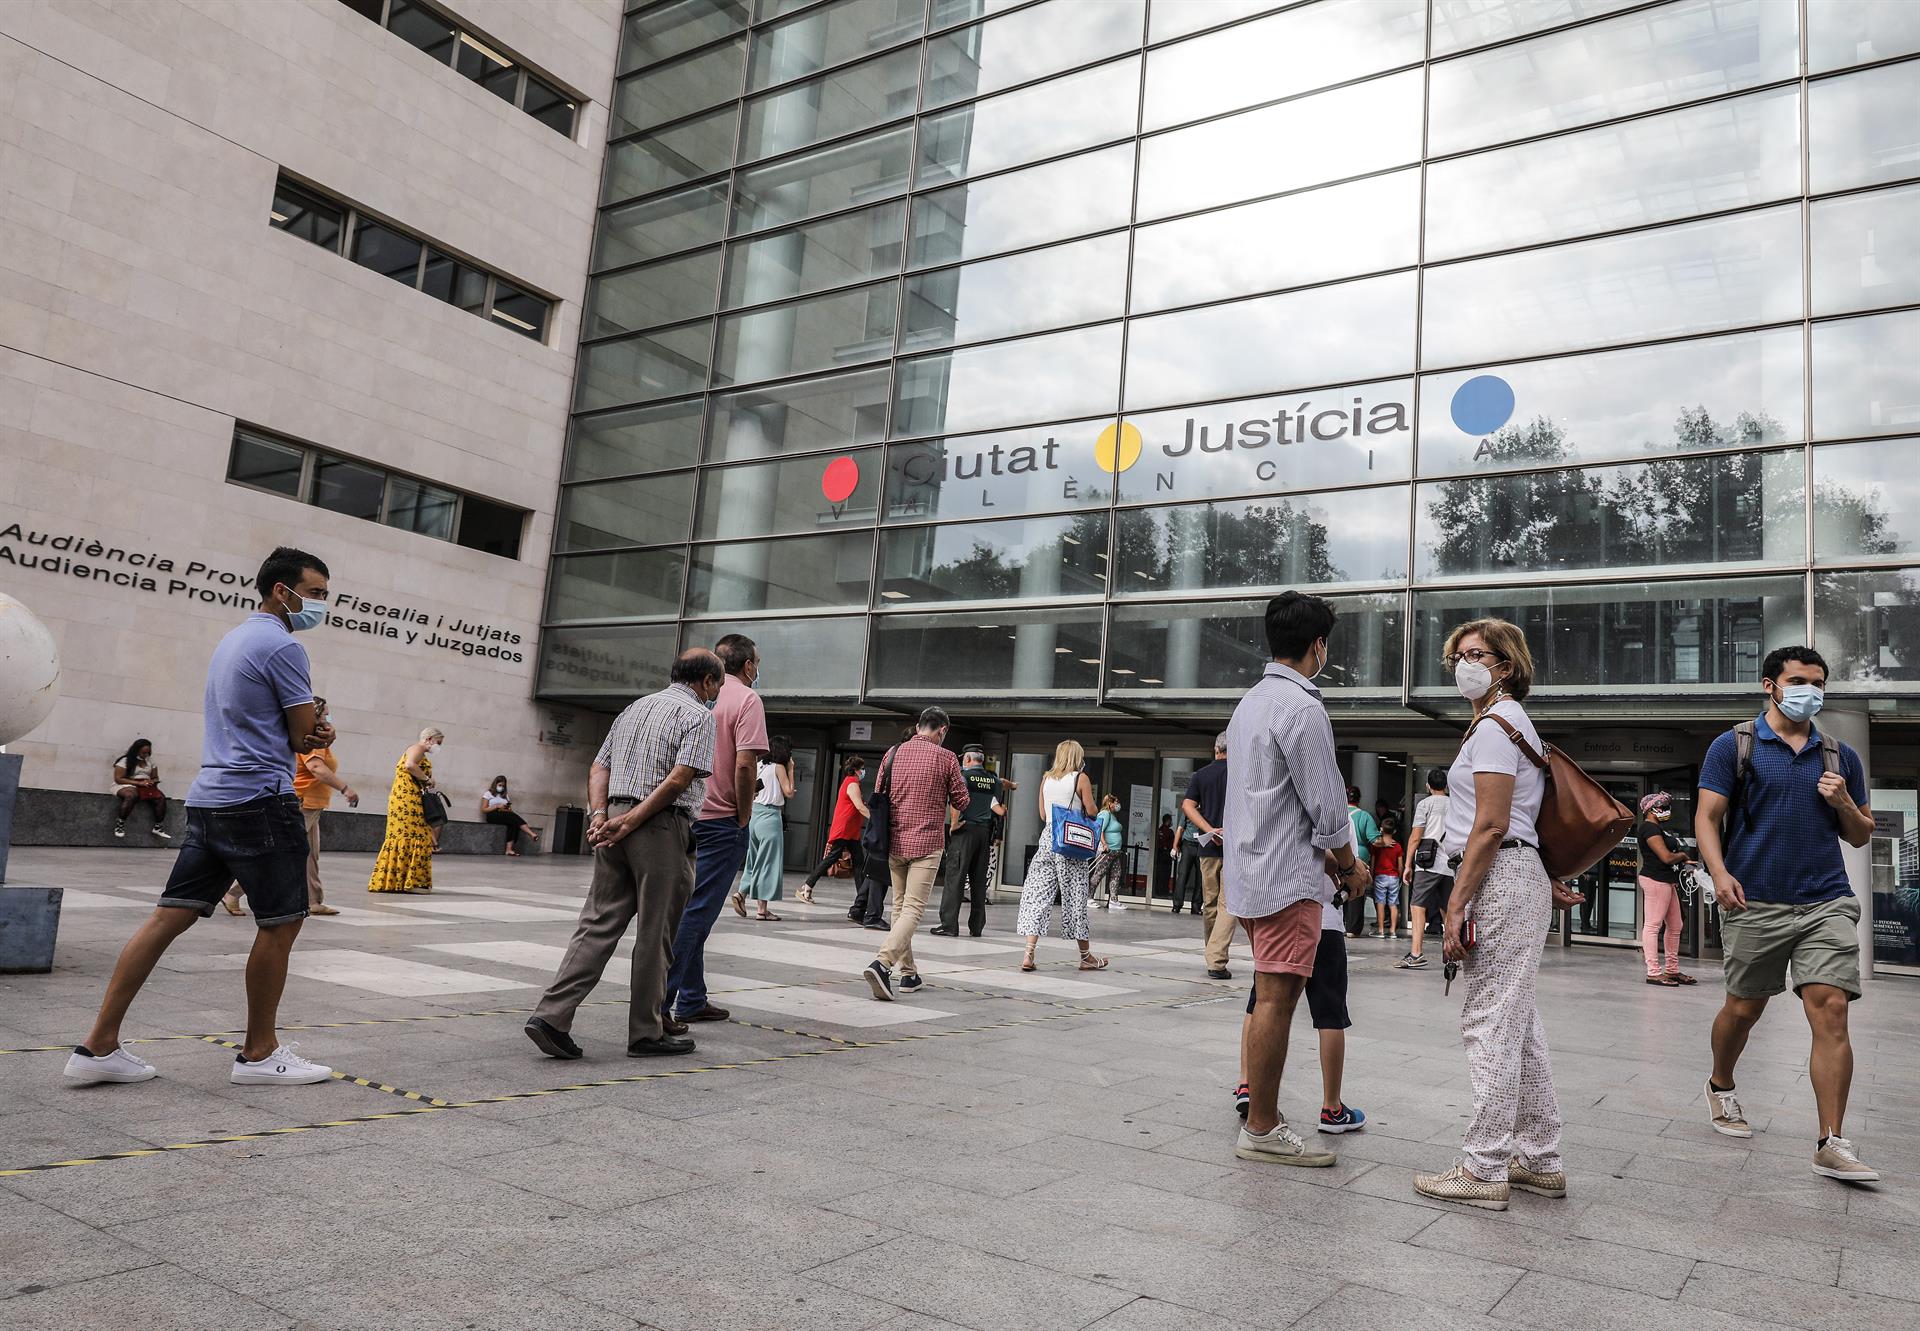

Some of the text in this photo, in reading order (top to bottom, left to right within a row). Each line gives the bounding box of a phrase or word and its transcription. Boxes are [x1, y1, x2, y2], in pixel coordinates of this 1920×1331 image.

[903, 397, 1410, 486] Ciutat Justícia
[0, 523, 174, 573] Audiència
[335, 593, 429, 625] Fiscalia
[437, 615, 444, 628] i
[449, 619, 521, 644] Jutjats
[0, 545, 522, 663] Audiencia Provin iscalía y Juzgados
[970, 776, 995, 784] GUARDIA
[1584, 742, 1674, 753] Entrada Entrada
